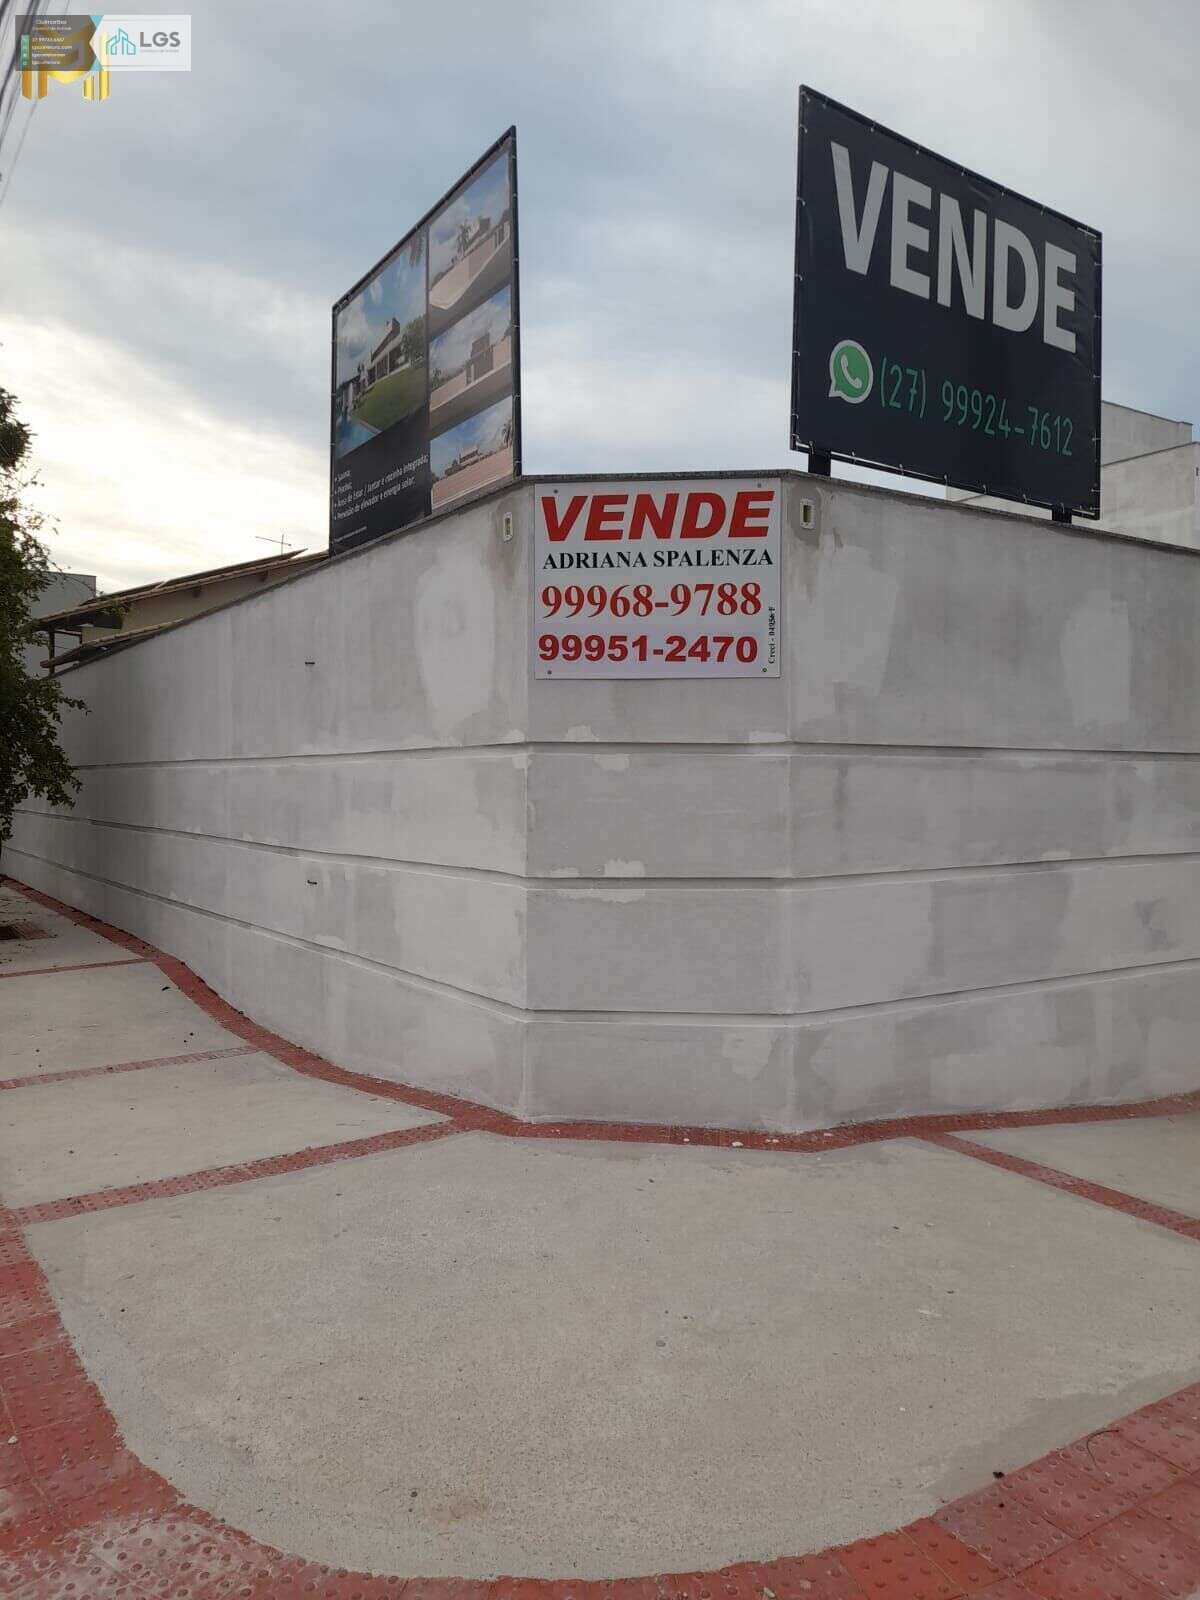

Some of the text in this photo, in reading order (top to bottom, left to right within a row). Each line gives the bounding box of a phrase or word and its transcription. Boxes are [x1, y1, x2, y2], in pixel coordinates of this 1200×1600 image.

[830, 141, 1077, 353] VENDE
[880, 357, 1073, 457] (27) 99924-7612
[541, 491, 775, 542] VENDE
[543, 549, 773, 569] ADRIANA SPALENZA
[541, 583, 762, 618] 99968-9788
[539, 635, 757, 662] 99951-2470
